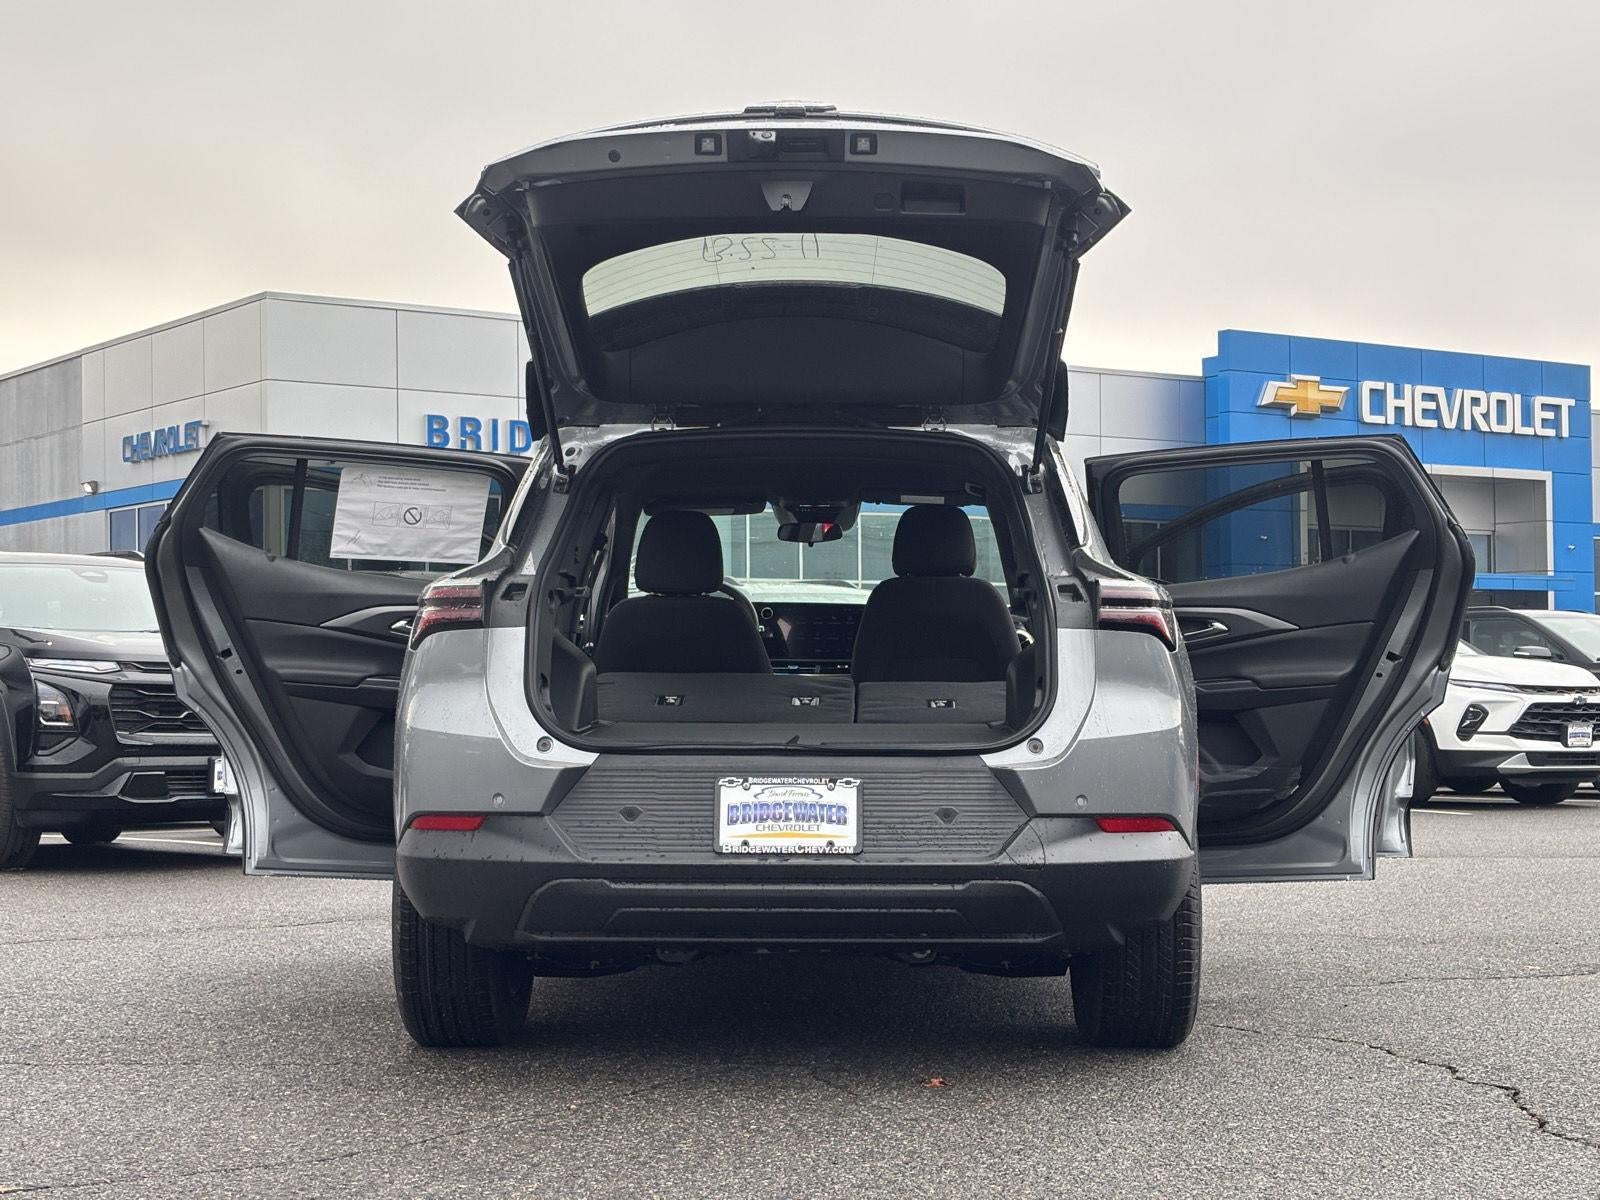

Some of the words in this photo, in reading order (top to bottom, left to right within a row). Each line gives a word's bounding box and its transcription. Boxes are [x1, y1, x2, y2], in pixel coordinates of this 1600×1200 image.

[1360, 380, 1575, 438] CHEVROLET
[122, 419, 206, 463] CHEVROLET
[426, 414, 533, 453] BRID
[727, 801, 848, 826] BRIDGEWATER
[755, 824, 822, 832] CHEVROLET
